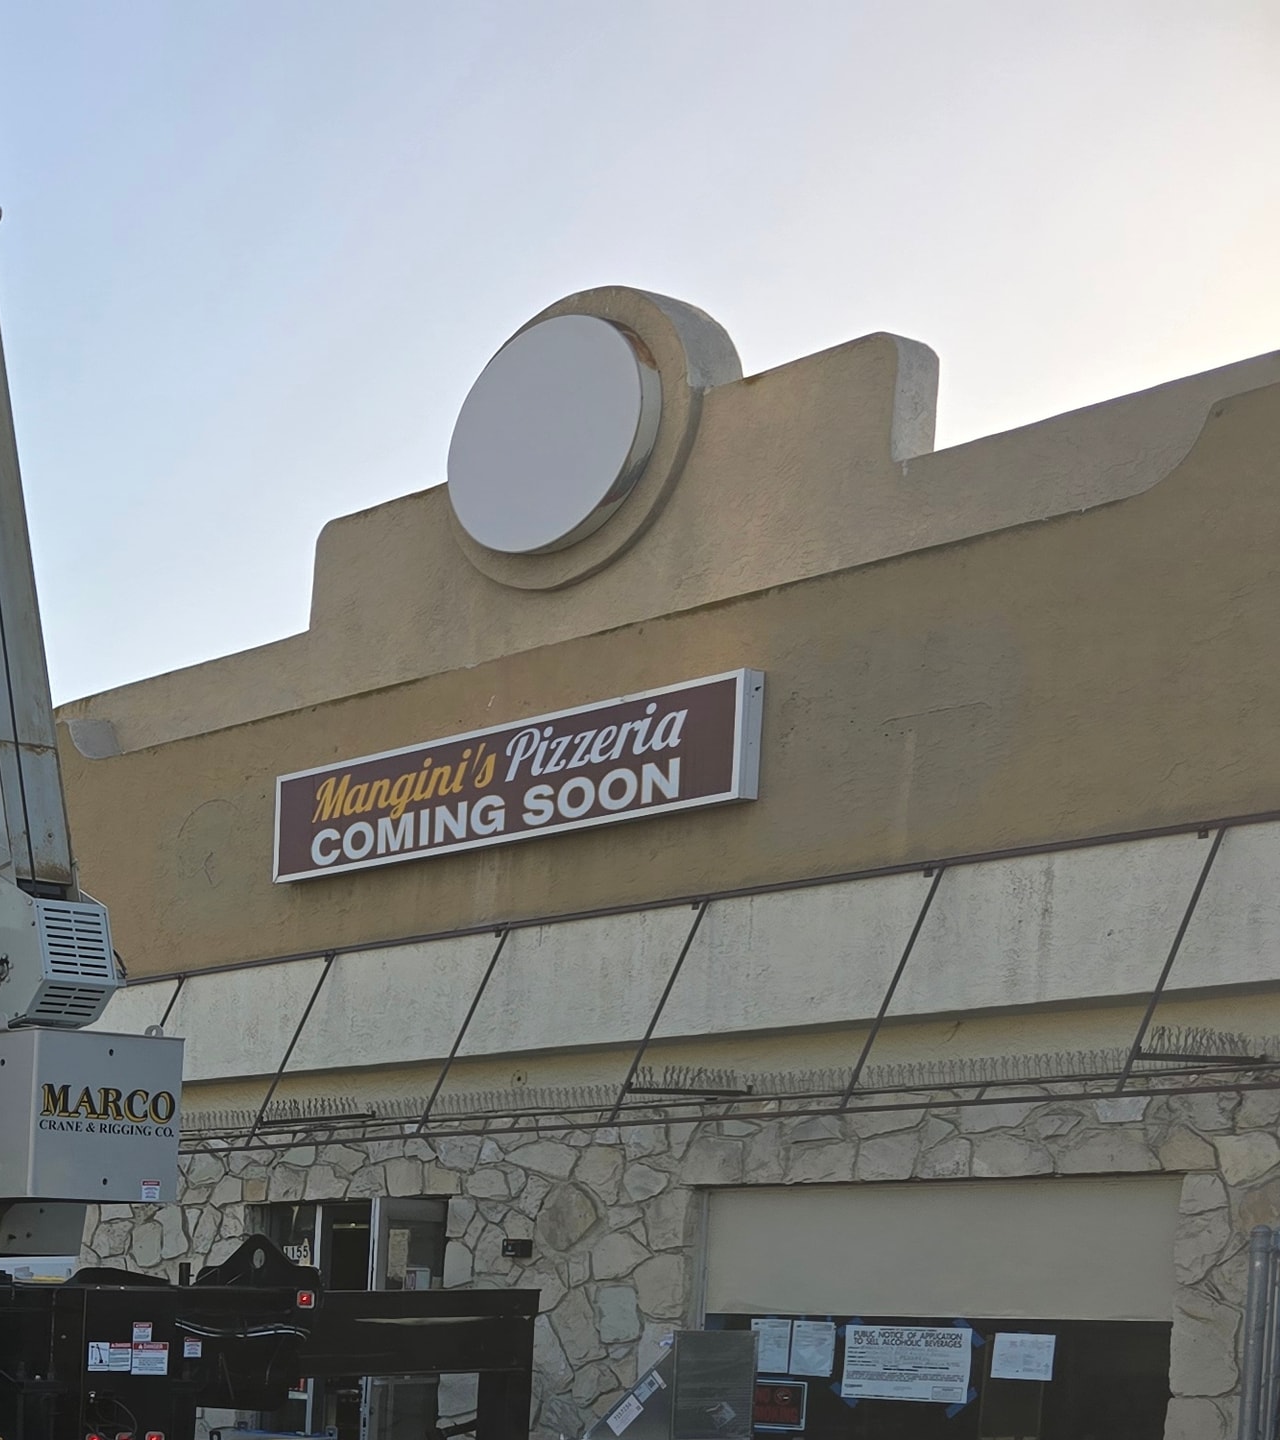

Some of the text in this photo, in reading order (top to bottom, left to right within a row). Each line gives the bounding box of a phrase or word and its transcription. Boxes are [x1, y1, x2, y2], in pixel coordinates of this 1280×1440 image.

[312, 702, 688, 824] Mangini's Pizzeria
[310, 757, 682, 866] COMING SOON
[40, 1083, 176, 1125] MARCO
[39, 1119, 175, 1138] CRANE & RIGGING CO.
[853, 1330, 876, 1338] PUBLIC
[878, 1331, 904, 1339] NOTICE
[921, 1332, 963, 1340] APPLICATION
[866, 1338, 879, 1346] SELL
[882, 1339, 922, 1347] ALCOHOLIC
[924, 1340, 963, 1348] BEVERAGES
